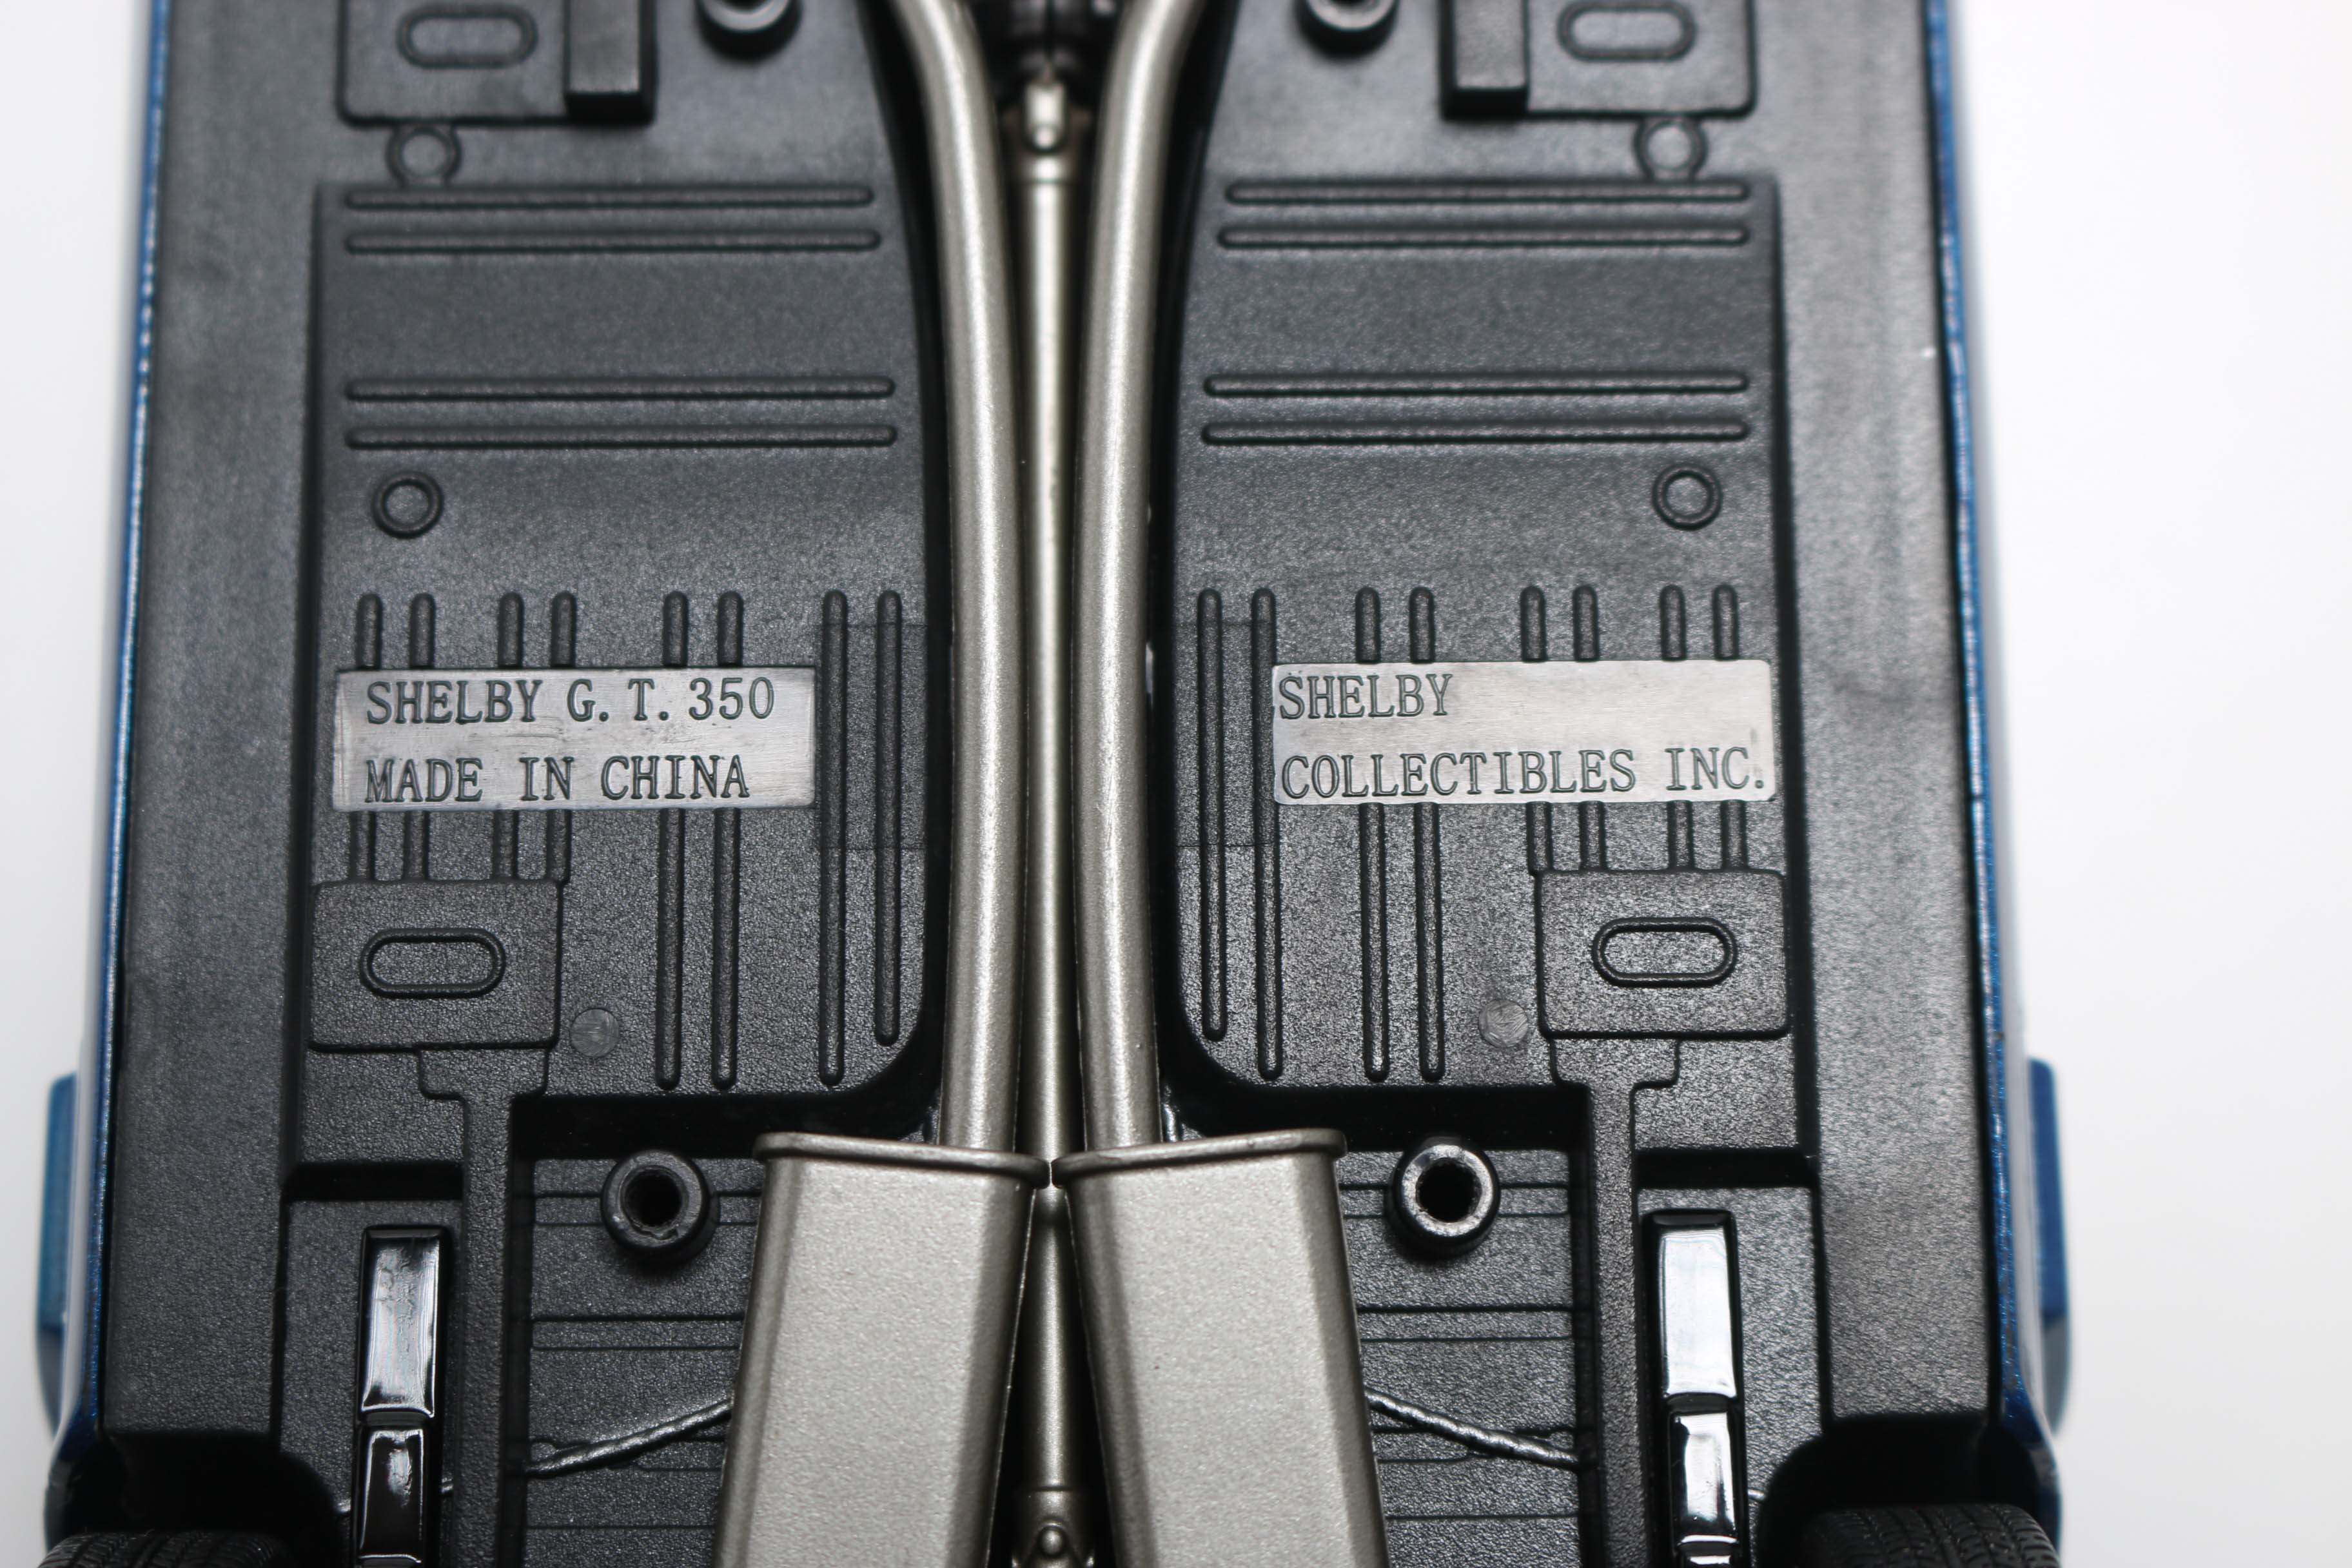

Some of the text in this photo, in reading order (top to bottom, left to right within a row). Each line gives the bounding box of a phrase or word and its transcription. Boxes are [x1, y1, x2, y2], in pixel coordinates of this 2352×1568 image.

[366, 680, 542, 723] SHELBY
[1279, 673, 1453, 720] SHELBY
[365, 754, 750, 802] MADE IN CHINA
[1281, 746, 1765, 798] COLLECTIBLES INC.
